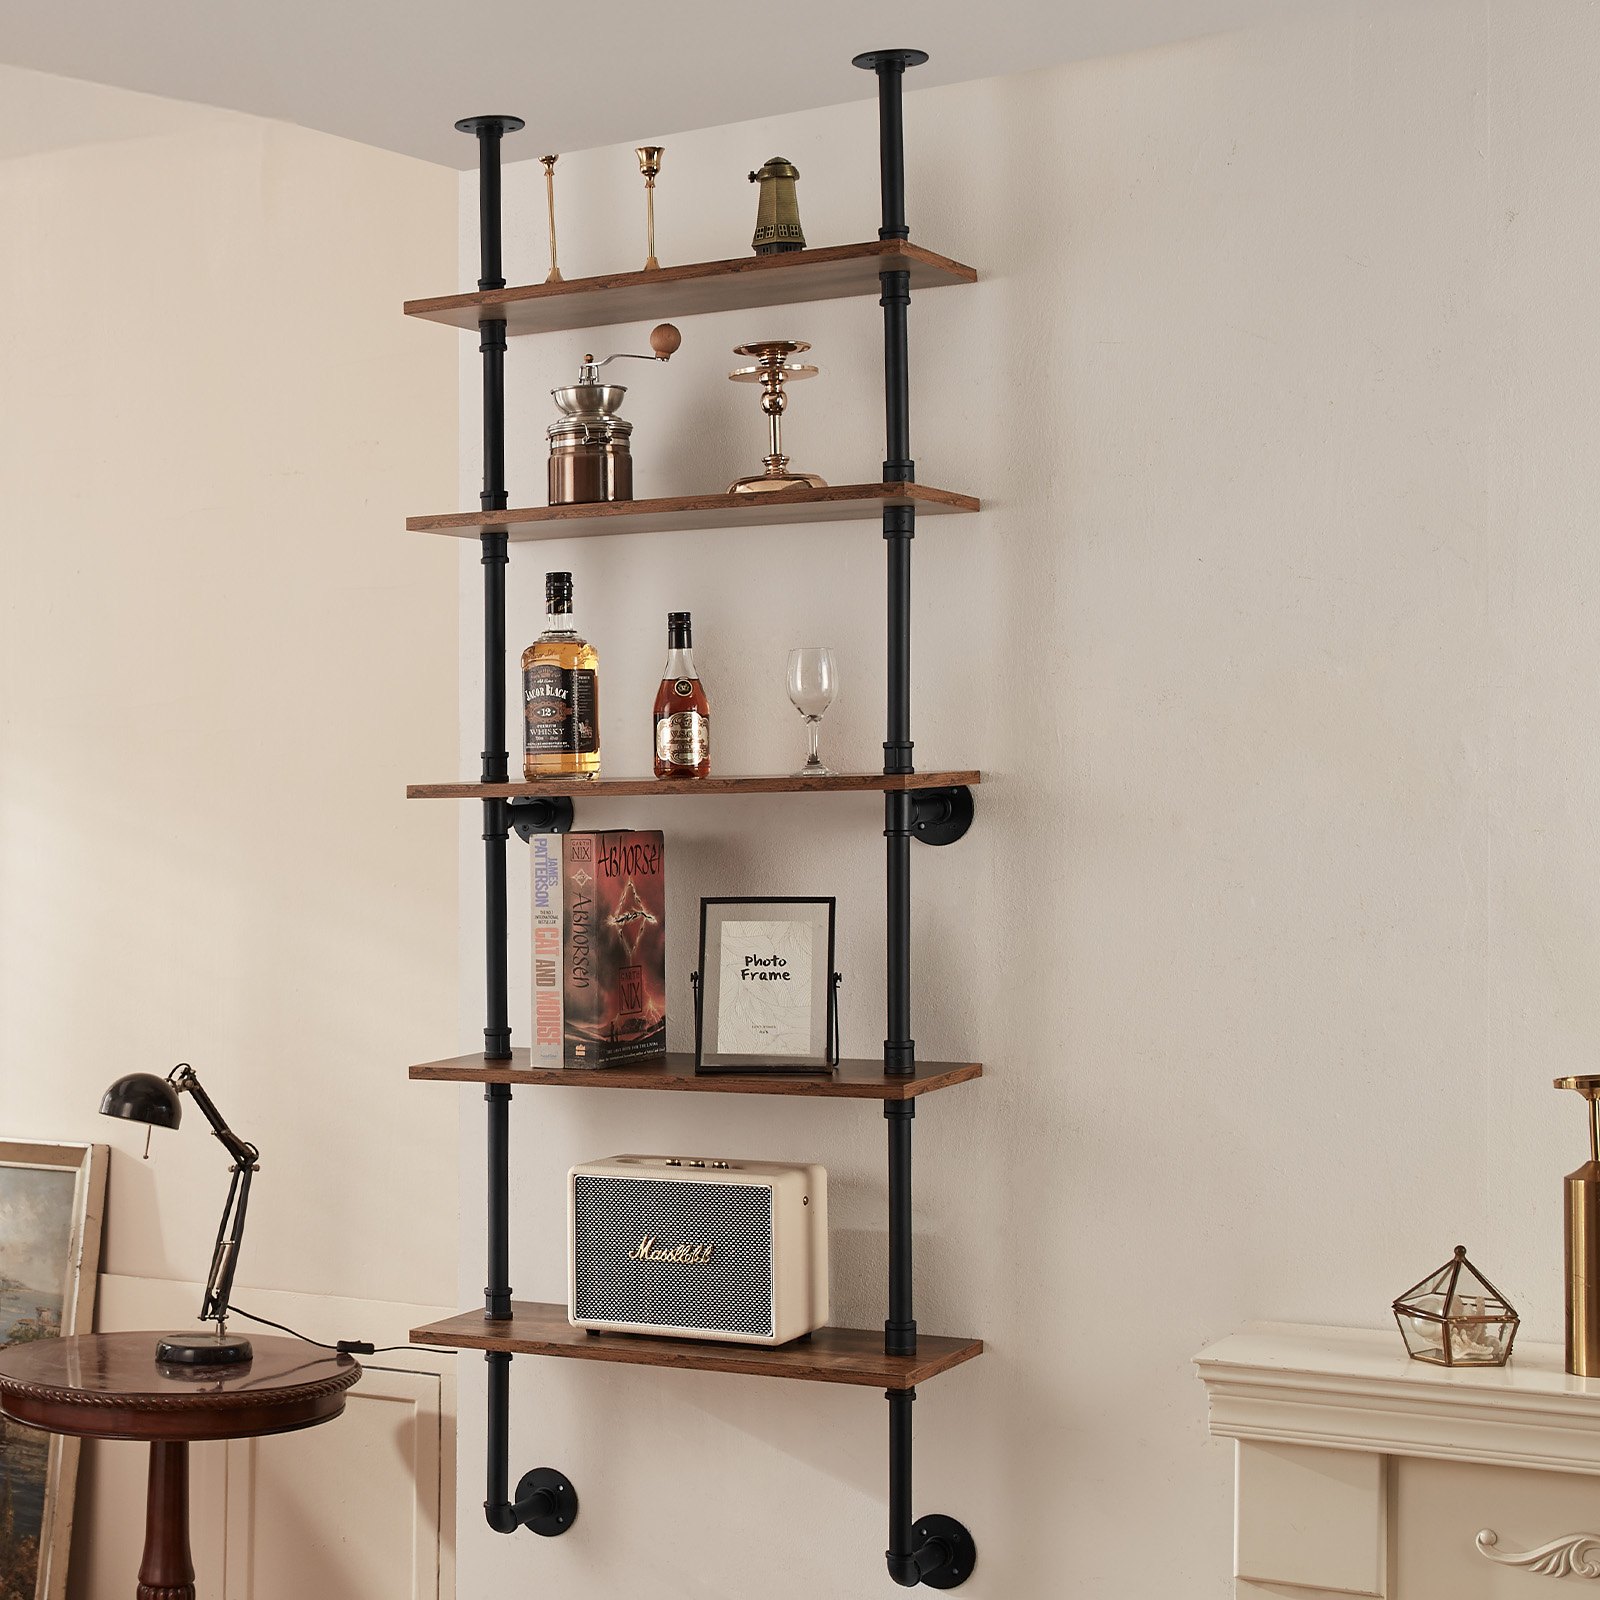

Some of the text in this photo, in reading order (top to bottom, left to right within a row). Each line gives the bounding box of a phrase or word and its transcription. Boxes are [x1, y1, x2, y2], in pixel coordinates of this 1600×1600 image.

[546, 684, 568, 699] BLACK
[541, 707, 552, 716] 12
[572, 847, 590, 860] NIX
[534, 837, 549, 908] PATTERSON
[548, 857, 559, 887] JAMES
[535, 927, 560, 956] CAT
[536, 959, 556, 987] AND
[741, 968, 791, 981] Frame
[744, 954, 787, 967] Photo
[621, 981, 641, 1011] NIX
[536, 990, 561, 1046] MOUSE
